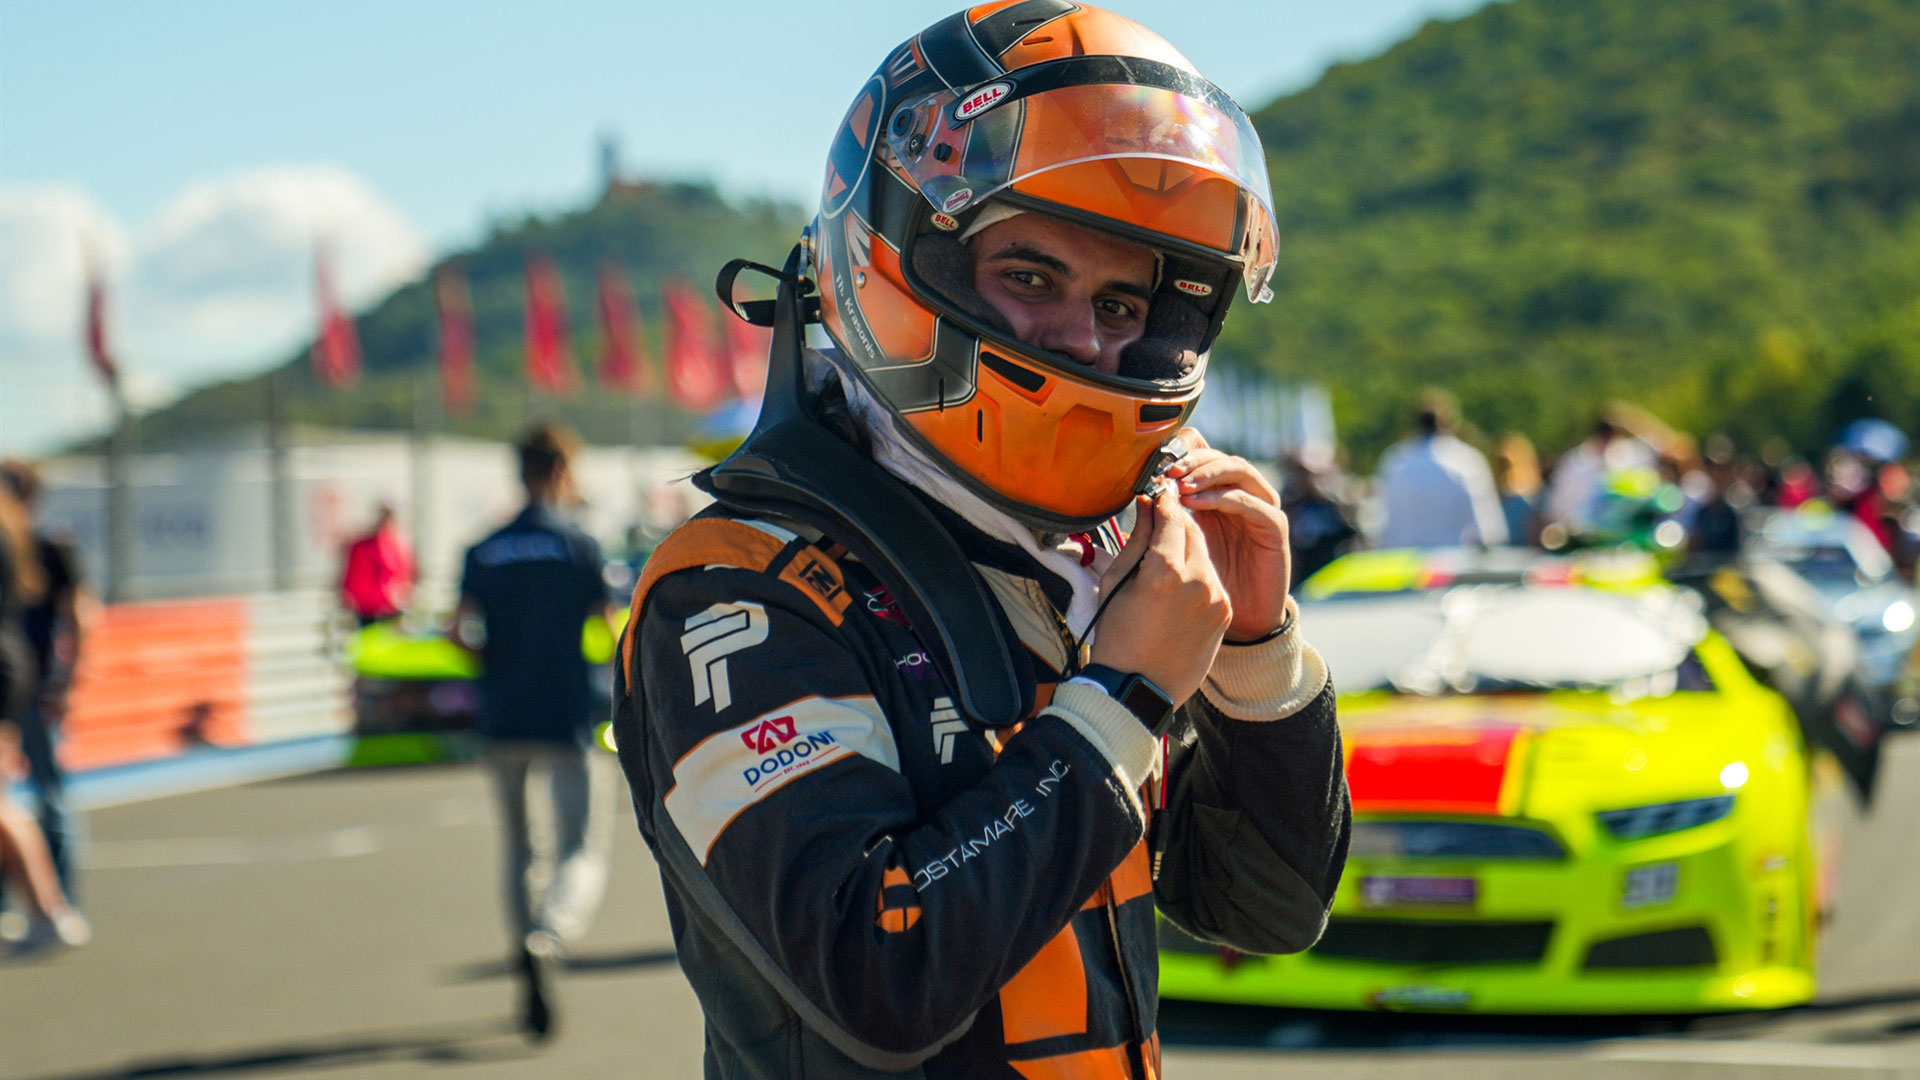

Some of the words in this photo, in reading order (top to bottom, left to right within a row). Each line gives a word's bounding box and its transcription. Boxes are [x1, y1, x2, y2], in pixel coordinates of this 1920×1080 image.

[962, 88, 1002, 115] BELL
[935, 214, 955, 229] BELL
[1179, 281, 1207, 293] BELL
[844, 297, 876, 360] Krasonis
[743, 730, 836, 787] DODONI
[1035, 759, 1072, 797] INC.
